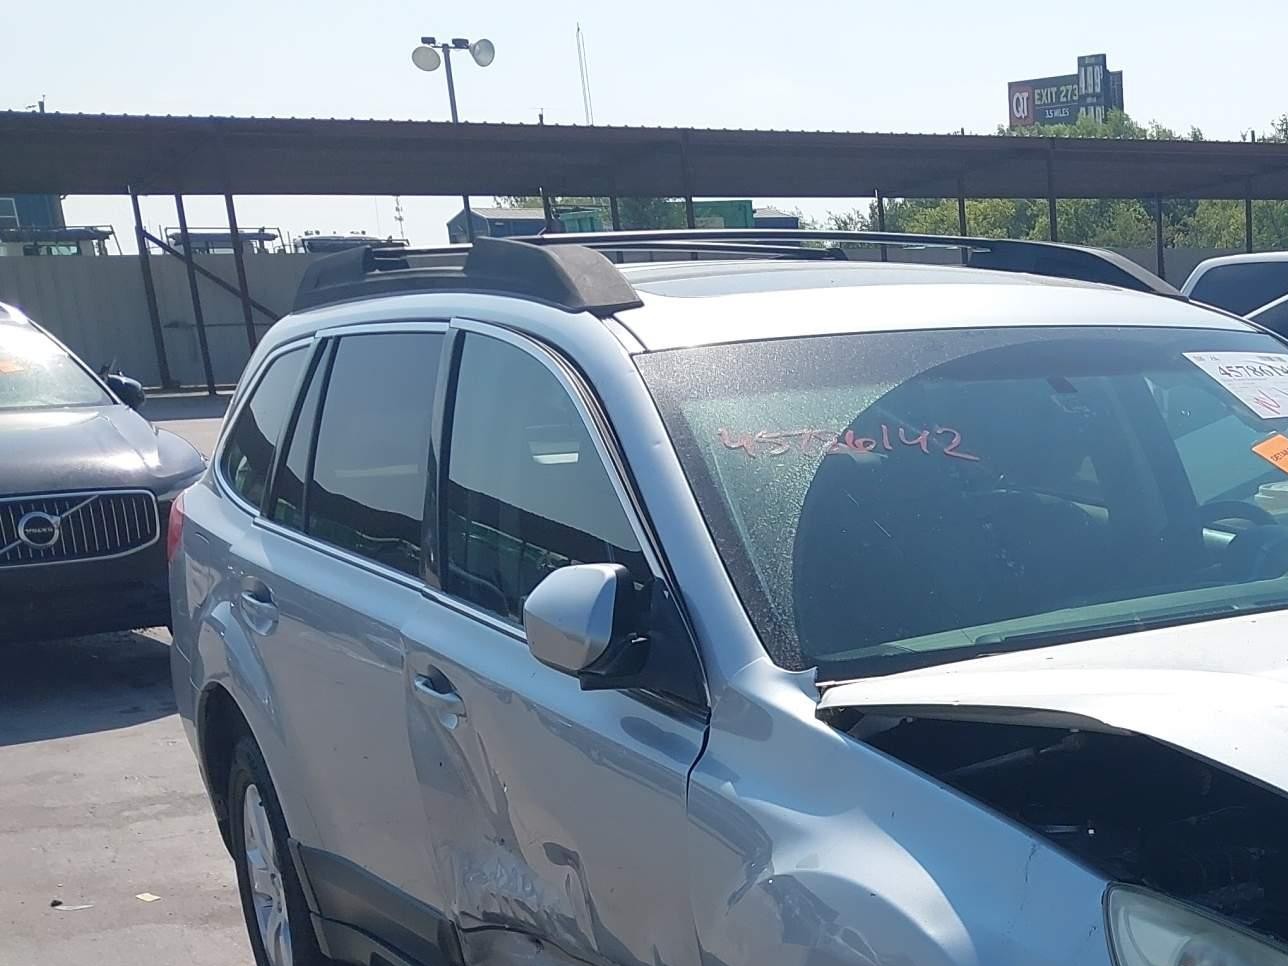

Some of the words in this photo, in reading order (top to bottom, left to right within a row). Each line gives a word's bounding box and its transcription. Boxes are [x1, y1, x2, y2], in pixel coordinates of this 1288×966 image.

[1012, 91, 1029, 119] QT
[1034, 86, 1057, 105] EXIT
[1060, 84, 1079, 102] 273
